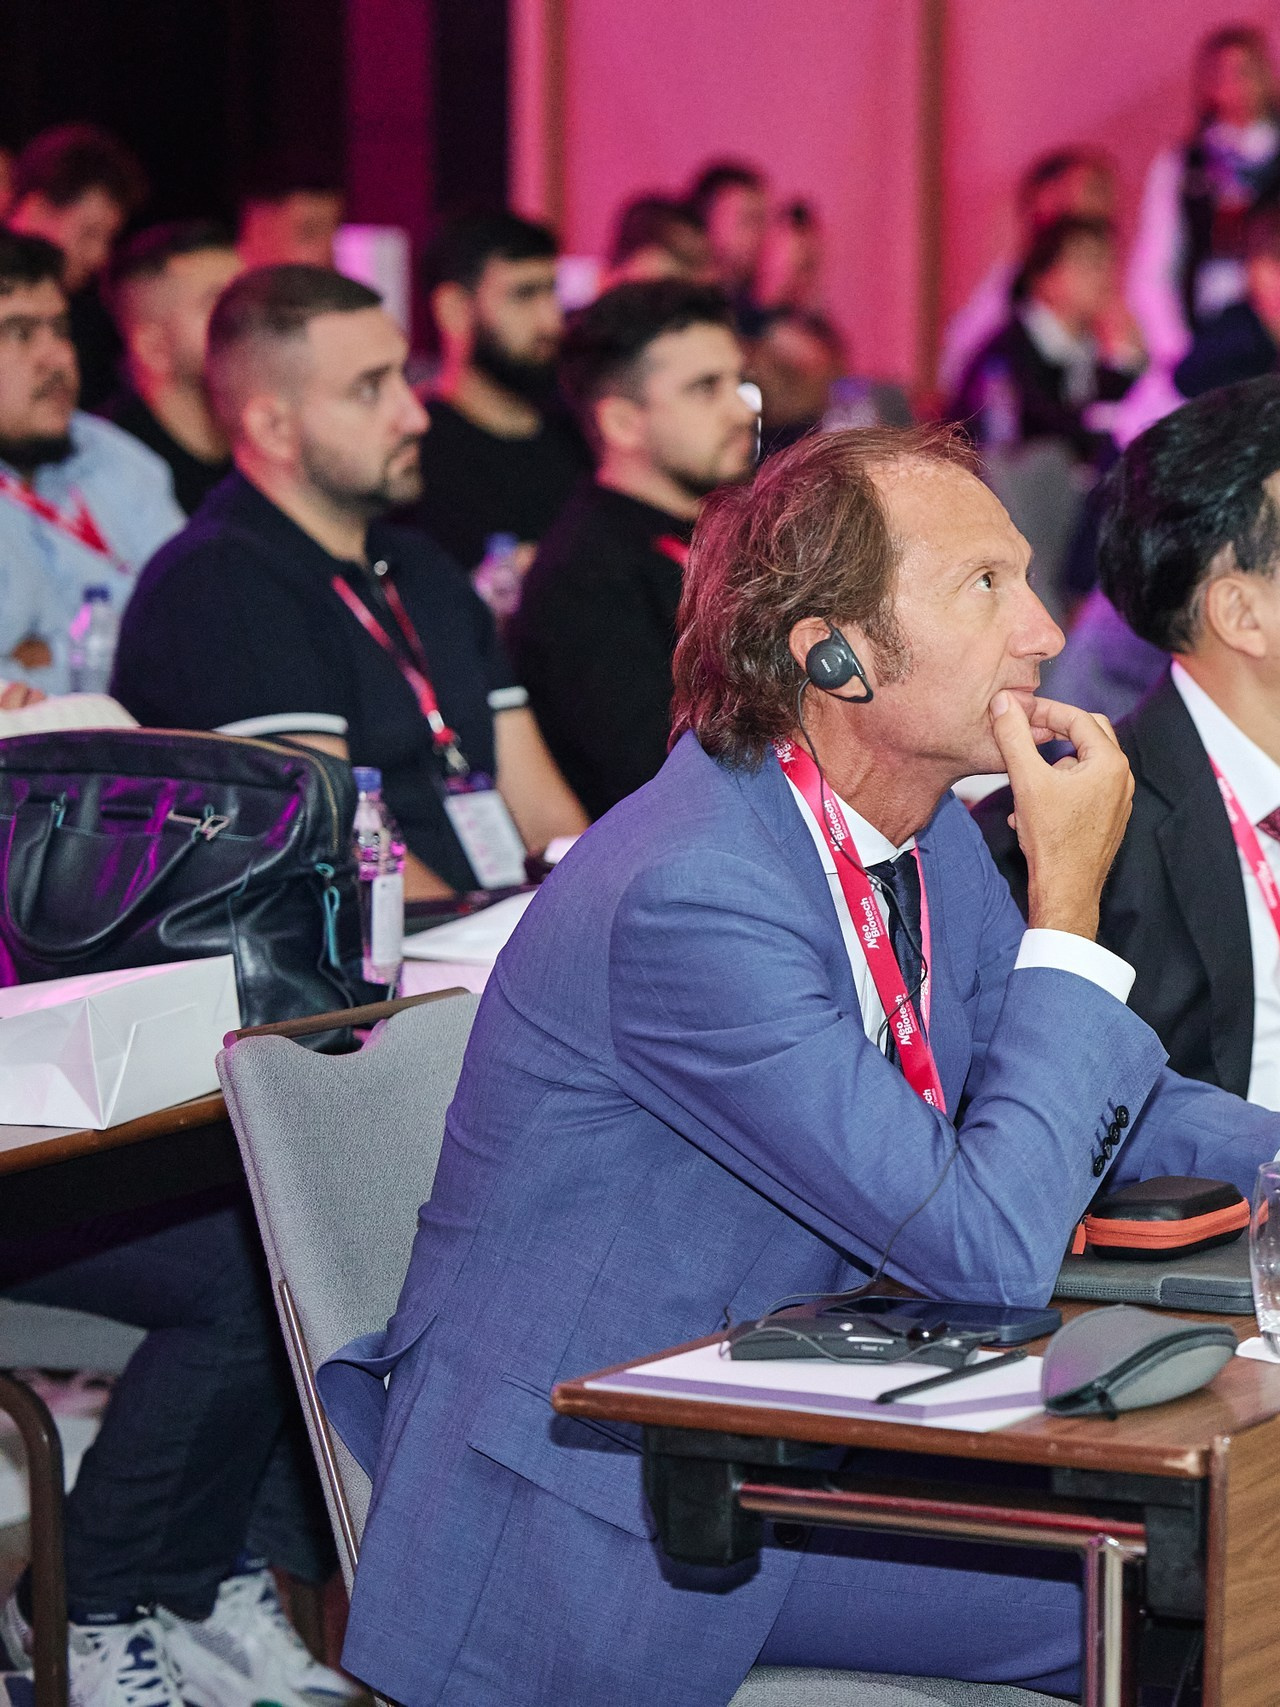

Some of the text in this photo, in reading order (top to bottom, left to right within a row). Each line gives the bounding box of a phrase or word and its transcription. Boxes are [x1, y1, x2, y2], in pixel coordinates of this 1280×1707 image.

[823, 800, 846, 840] Biotech
[860, 897, 881, 937] Biotech
[862, 924, 880, 949] Neo
[896, 1021, 912, 1046] Neo
